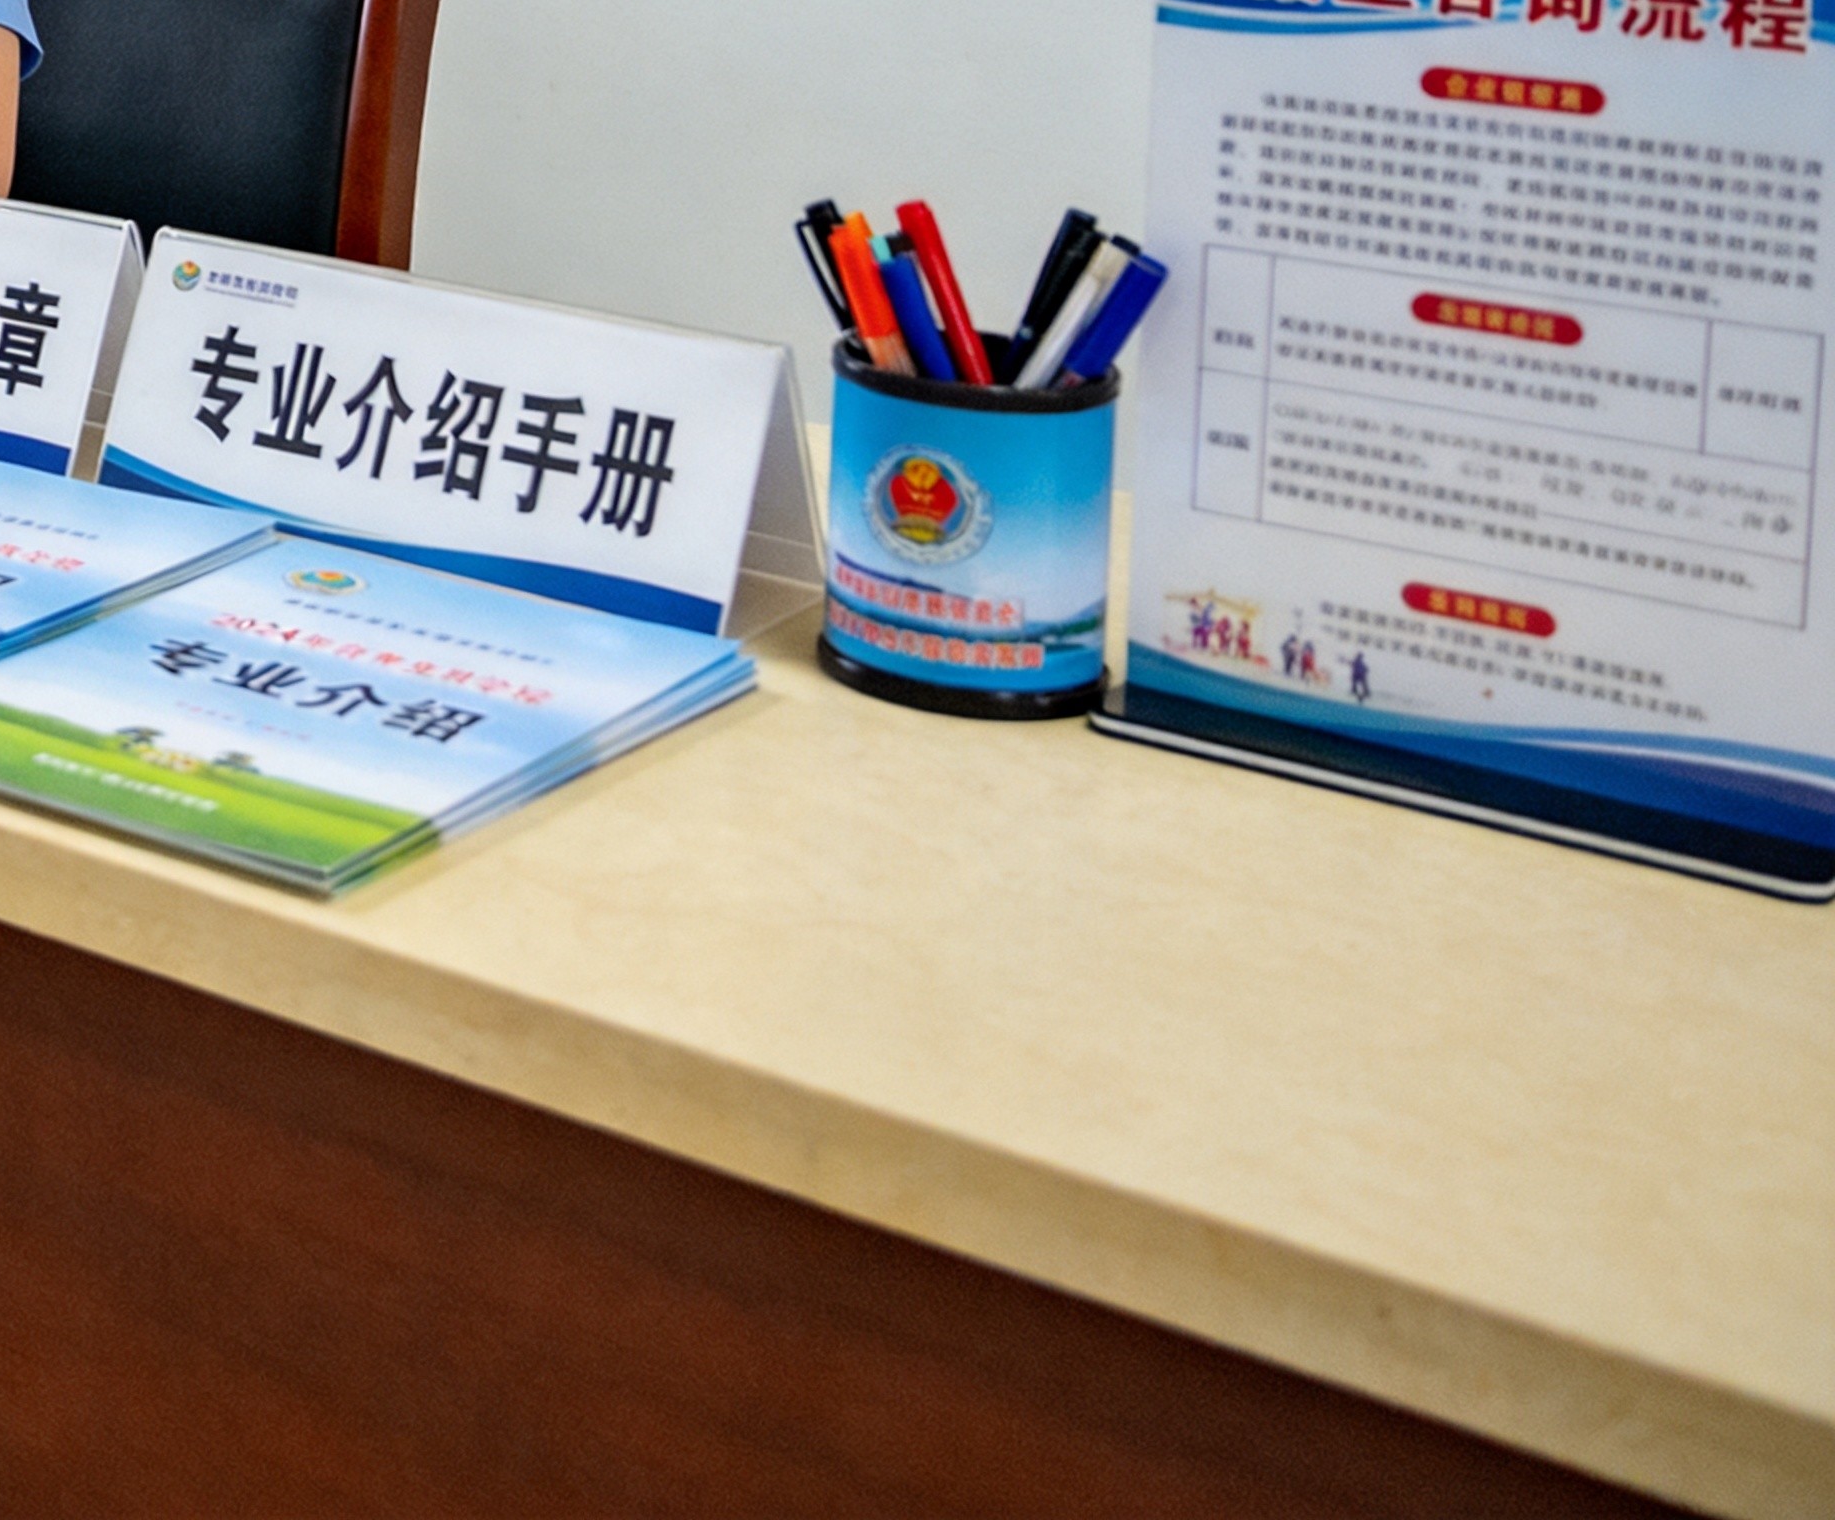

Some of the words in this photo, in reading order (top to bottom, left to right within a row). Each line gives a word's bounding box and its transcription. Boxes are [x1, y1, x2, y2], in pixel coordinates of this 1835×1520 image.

[191, 325, 675, 537] 专业介绍手册
[145, 637, 485, 743] 专业介绍
